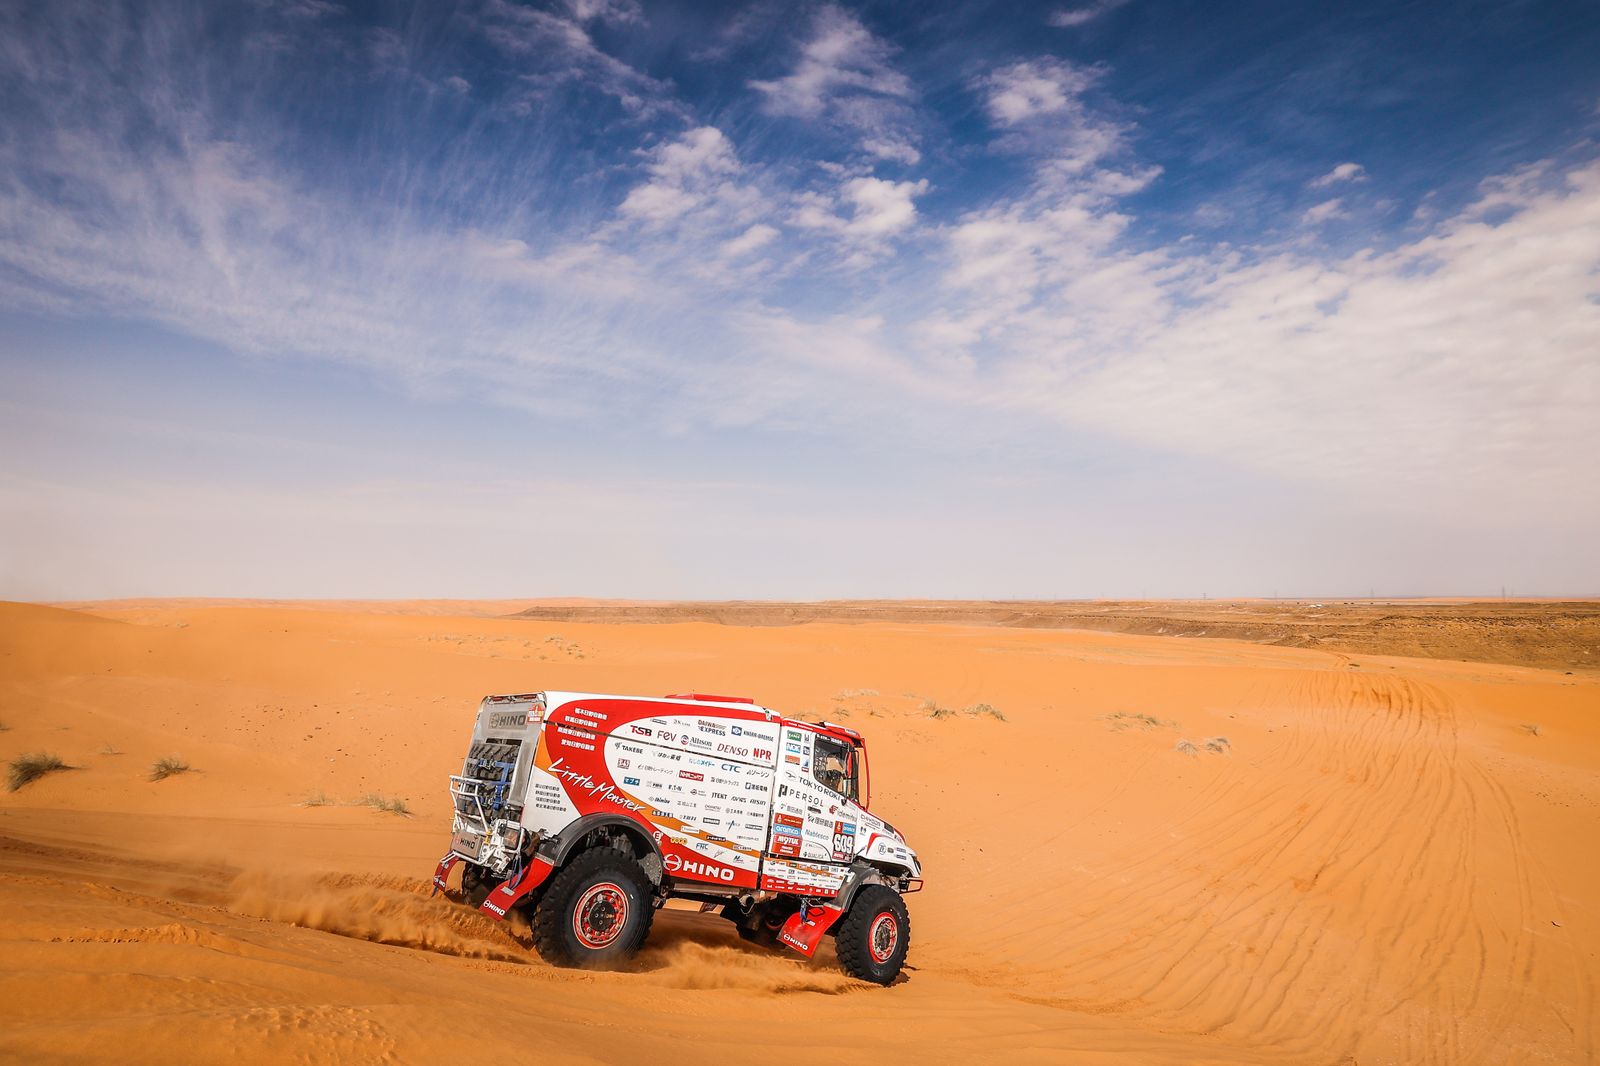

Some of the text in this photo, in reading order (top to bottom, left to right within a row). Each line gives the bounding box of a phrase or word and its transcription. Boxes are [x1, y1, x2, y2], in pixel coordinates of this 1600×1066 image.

[500, 714, 527, 726] HINO
[630, 725, 652, 737] TSB
[700, 725, 726, 737] EXPRESS
[622, 745, 643, 754] TAKEBE
[717, 743, 749, 757] DENSO
[753, 747, 772, 760] NPR
[721, 763, 742, 773] CTC
[547, 757, 647, 812] Little Monster
[799, 776, 841, 801] TOKYO ROKI
[711, 792, 728, 800] JTEKT
[789, 788, 824, 807] PERSOL
[776, 825, 799, 835] aramco
[805, 829, 829, 841] Nabtesco
[460, 838, 476, 849] HINO
[777, 835, 799, 845] MOTUL
[834, 834, 854, 854] 609
[683, 859, 735, 881] HINO
[489, 903, 506, 916] HINO
[789, 937, 809, 951] HINO
